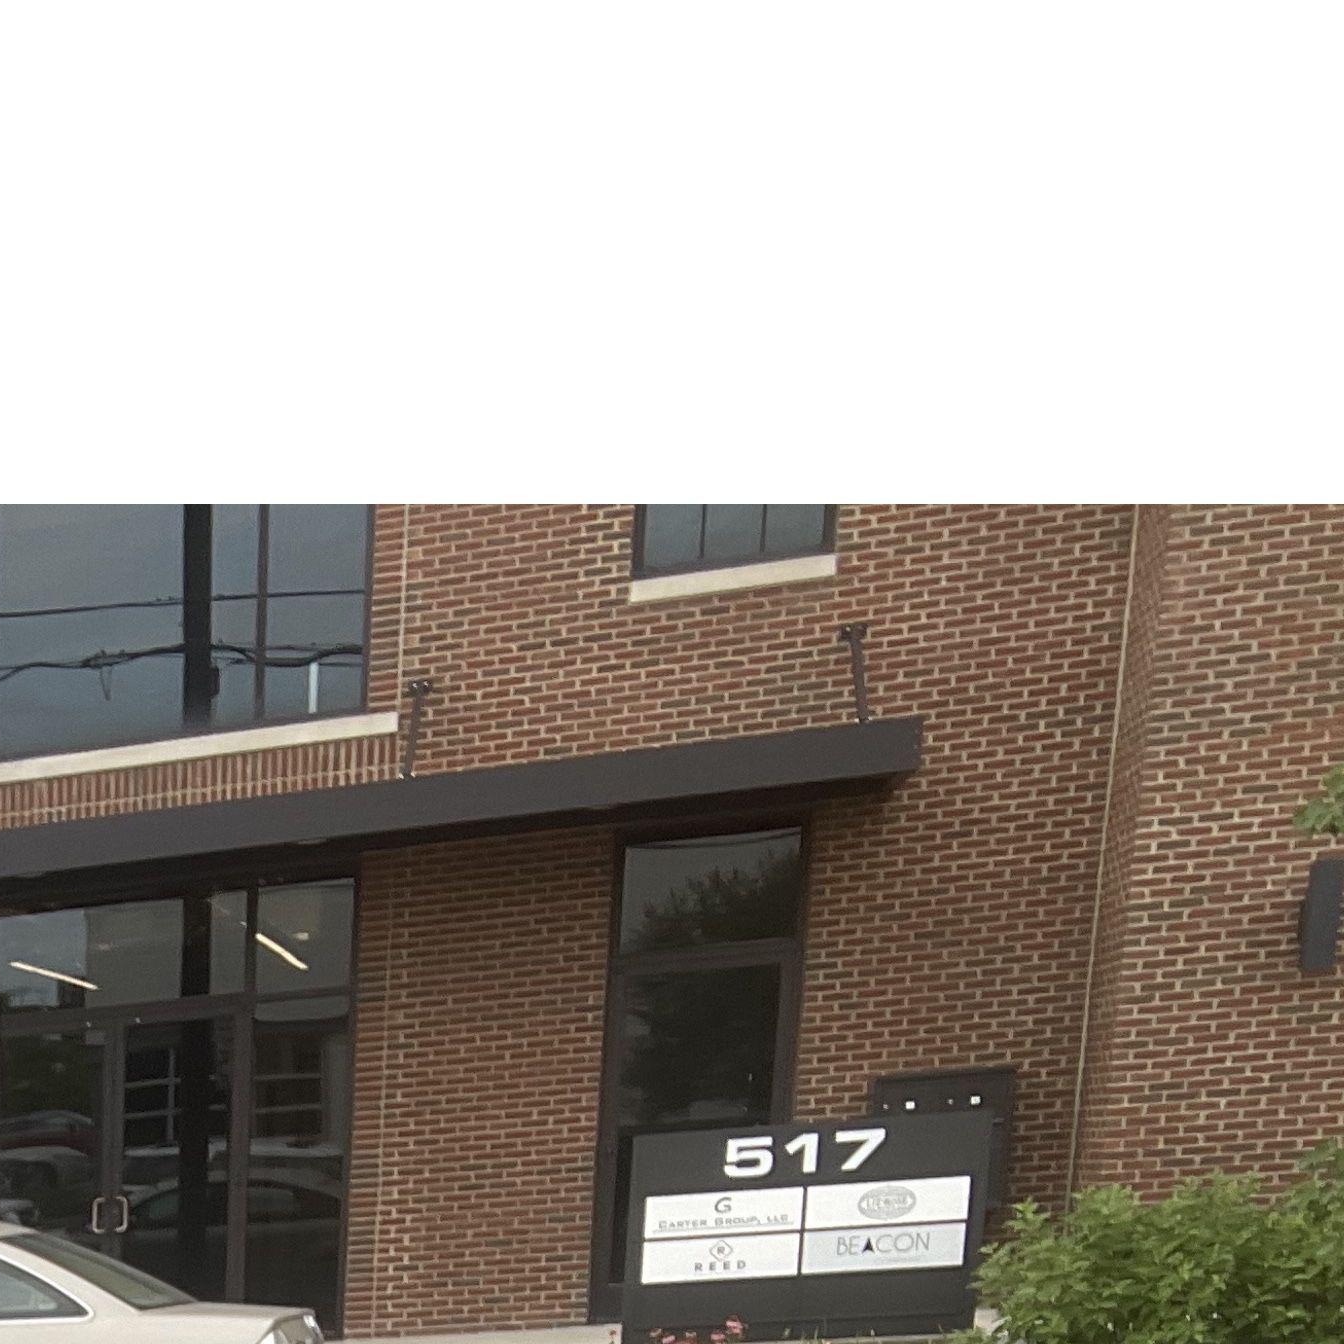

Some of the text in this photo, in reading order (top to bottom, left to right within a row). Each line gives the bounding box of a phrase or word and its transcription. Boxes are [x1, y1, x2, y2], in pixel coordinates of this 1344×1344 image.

[723, 1128, 887, 1178] 517
[658, 1219, 708, 1230] CARTER
[836, 1232, 930, 1256] BEACON
[694, 1259, 746, 1272] REED
